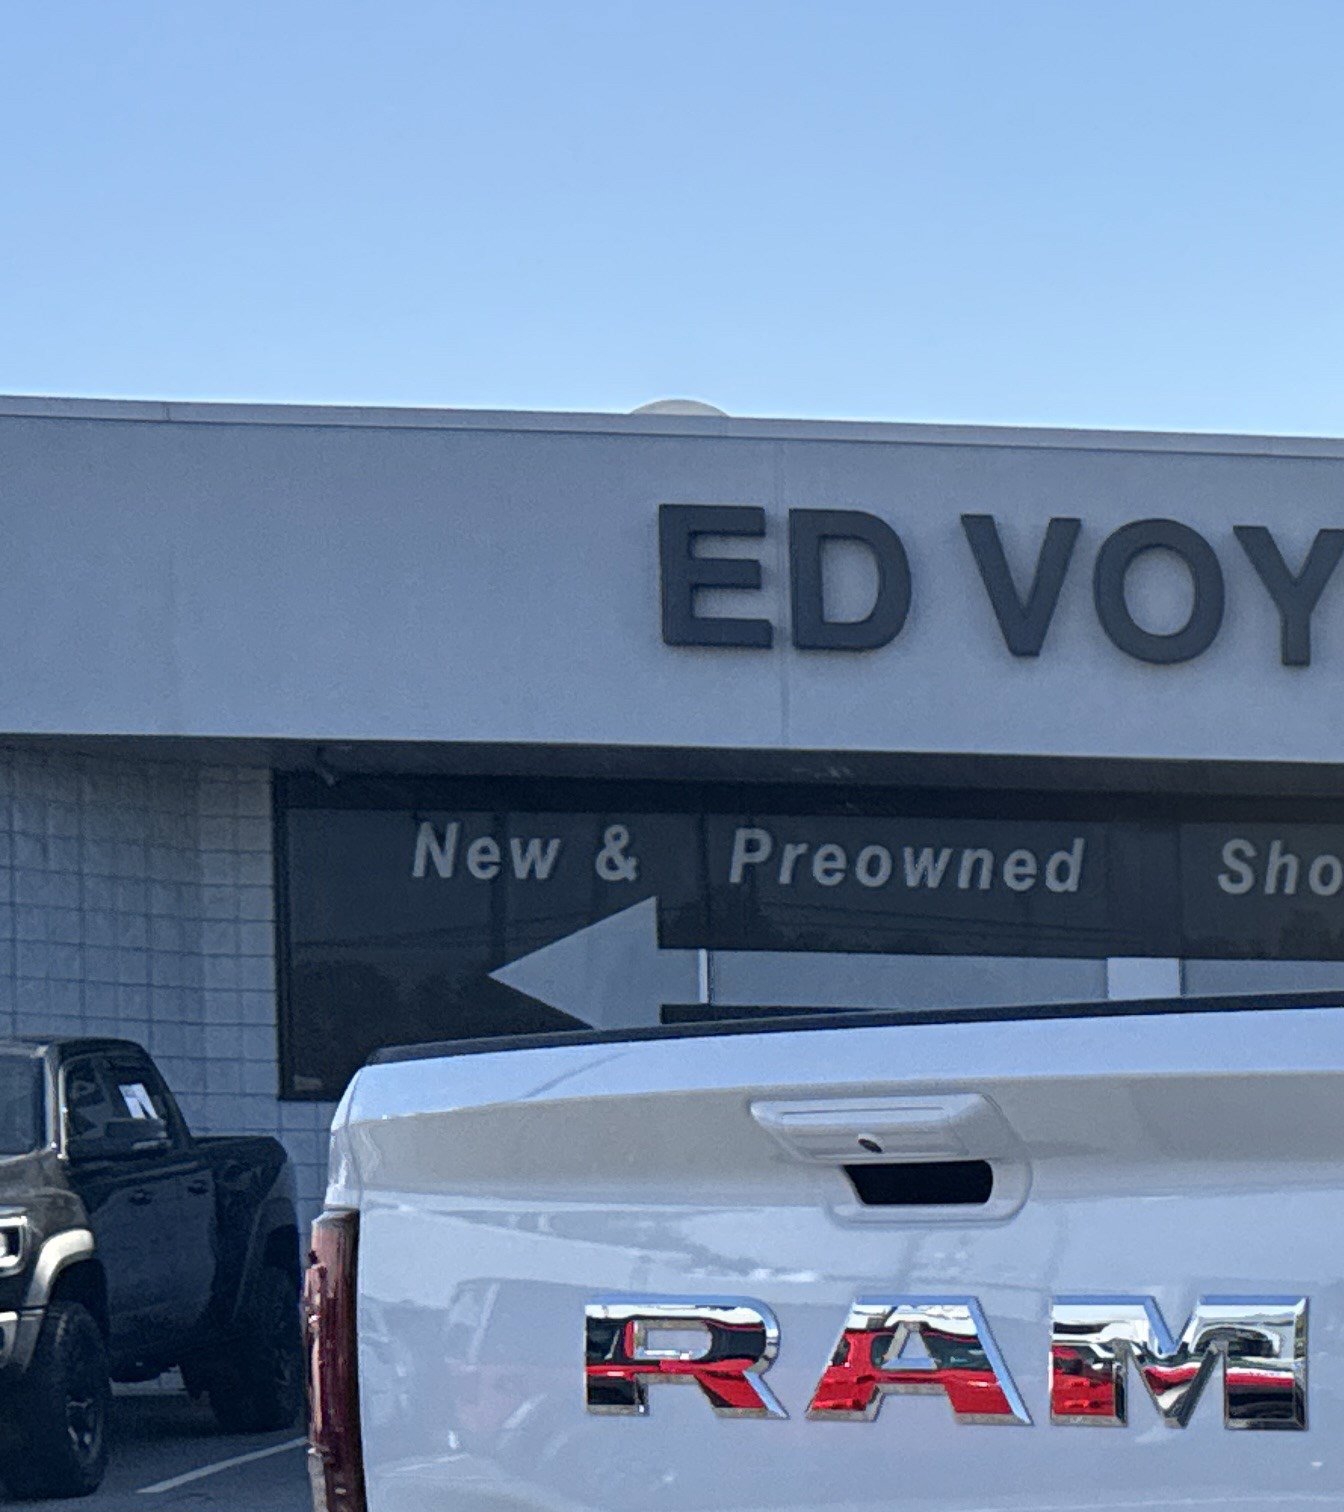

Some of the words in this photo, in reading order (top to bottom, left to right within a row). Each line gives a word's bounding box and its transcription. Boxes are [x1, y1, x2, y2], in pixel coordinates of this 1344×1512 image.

[657, 502, 912, 652] ED
[410, 819, 562, 882] New
[594, 823, 640, 883] &
[729, 827, 1086, 894] Preowned
[584, 1294, 1310, 1432] RAM
